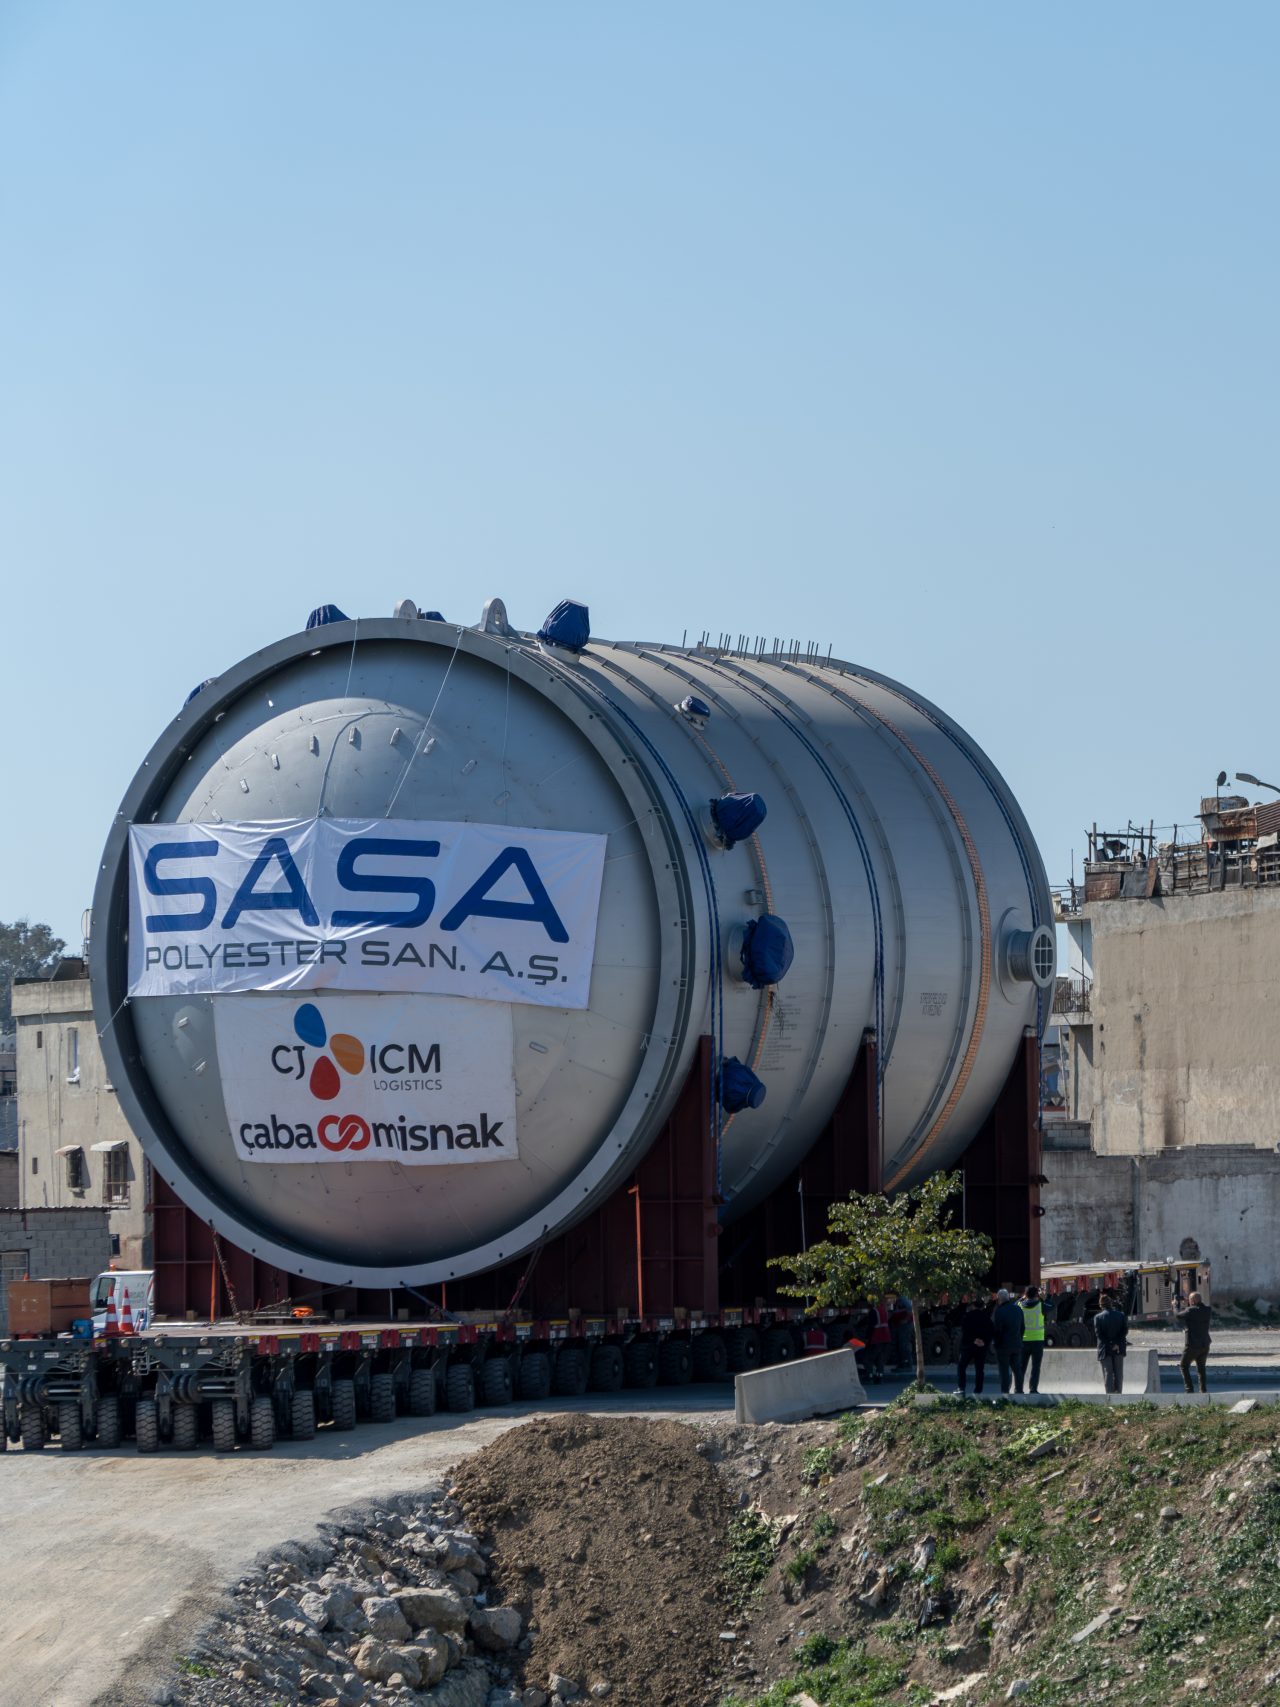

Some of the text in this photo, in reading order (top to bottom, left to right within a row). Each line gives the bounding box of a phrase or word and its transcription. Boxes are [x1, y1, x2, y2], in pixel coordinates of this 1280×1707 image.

[144, 837, 570, 943] SASA
[145, 940, 347, 972] POLYESTER
[361, 940, 467, 972] SAN.
[271, 1043, 442, 1080] CJ ICM
[373, 1078, 443, 1092] LOGISTICS
[240, 1112, 505, 1156] çaba misnak
